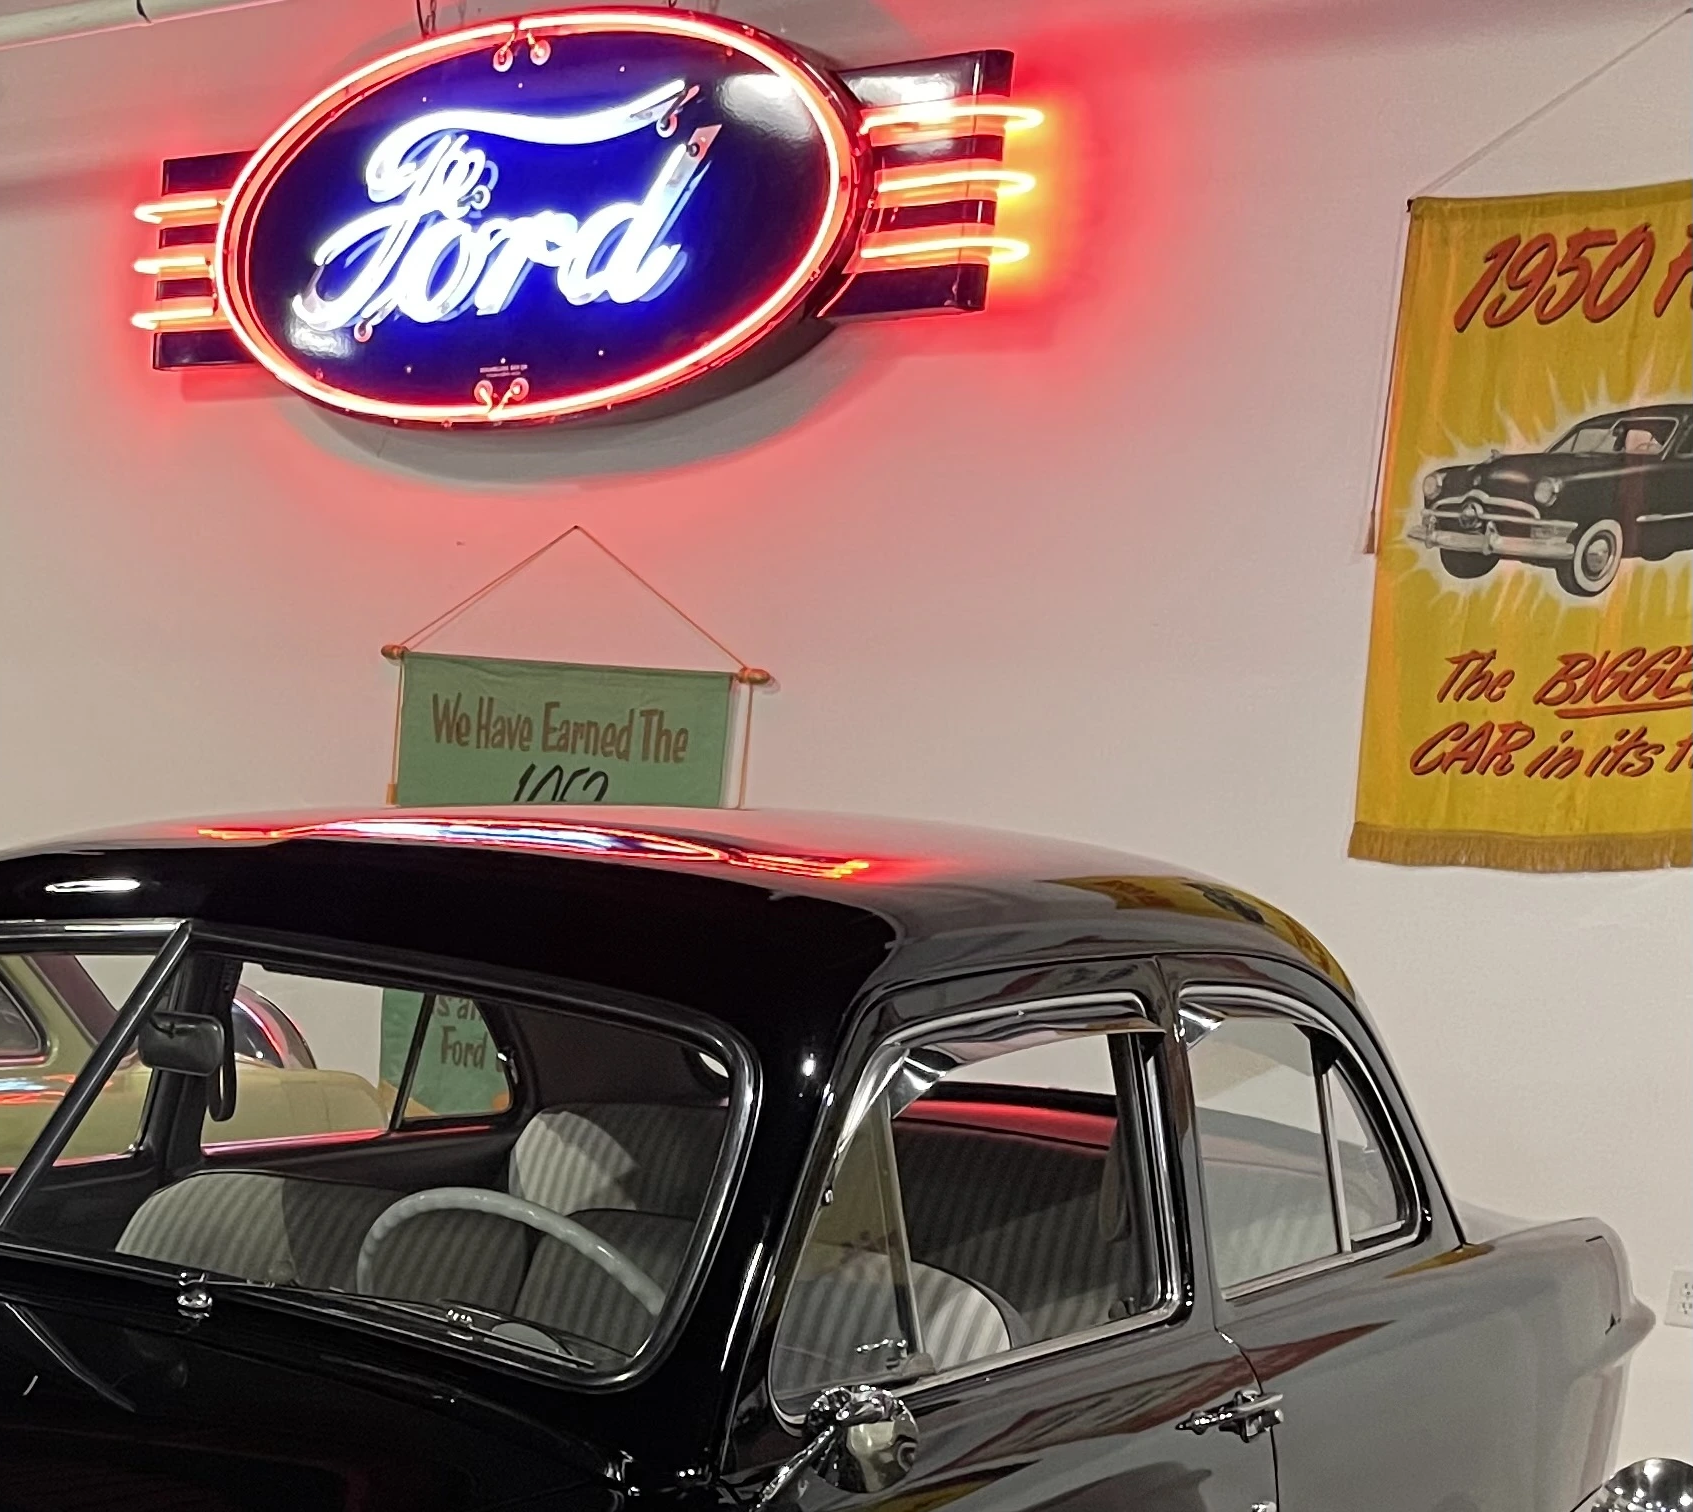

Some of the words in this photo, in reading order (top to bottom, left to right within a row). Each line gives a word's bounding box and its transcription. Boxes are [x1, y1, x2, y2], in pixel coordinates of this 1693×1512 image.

[292, 80, 721, 331] Ford
[1453, 222, 1656, 333] 1950
[1437, 649, 1515, 703] The
[1533, 645, 1693, 707] BIGGE
[433, 693, 471, 747] We
[475, 696, 533, 752] Have
[542, 701, 635, 762] Earned
[640, 709, 689, 763] The
[1410, 720, 1535, 776] CAR
[1524, 730, 1584, 779] in
[1585, 726, 1665, 778] its
[440, 1024, 488, 1071] Ford
